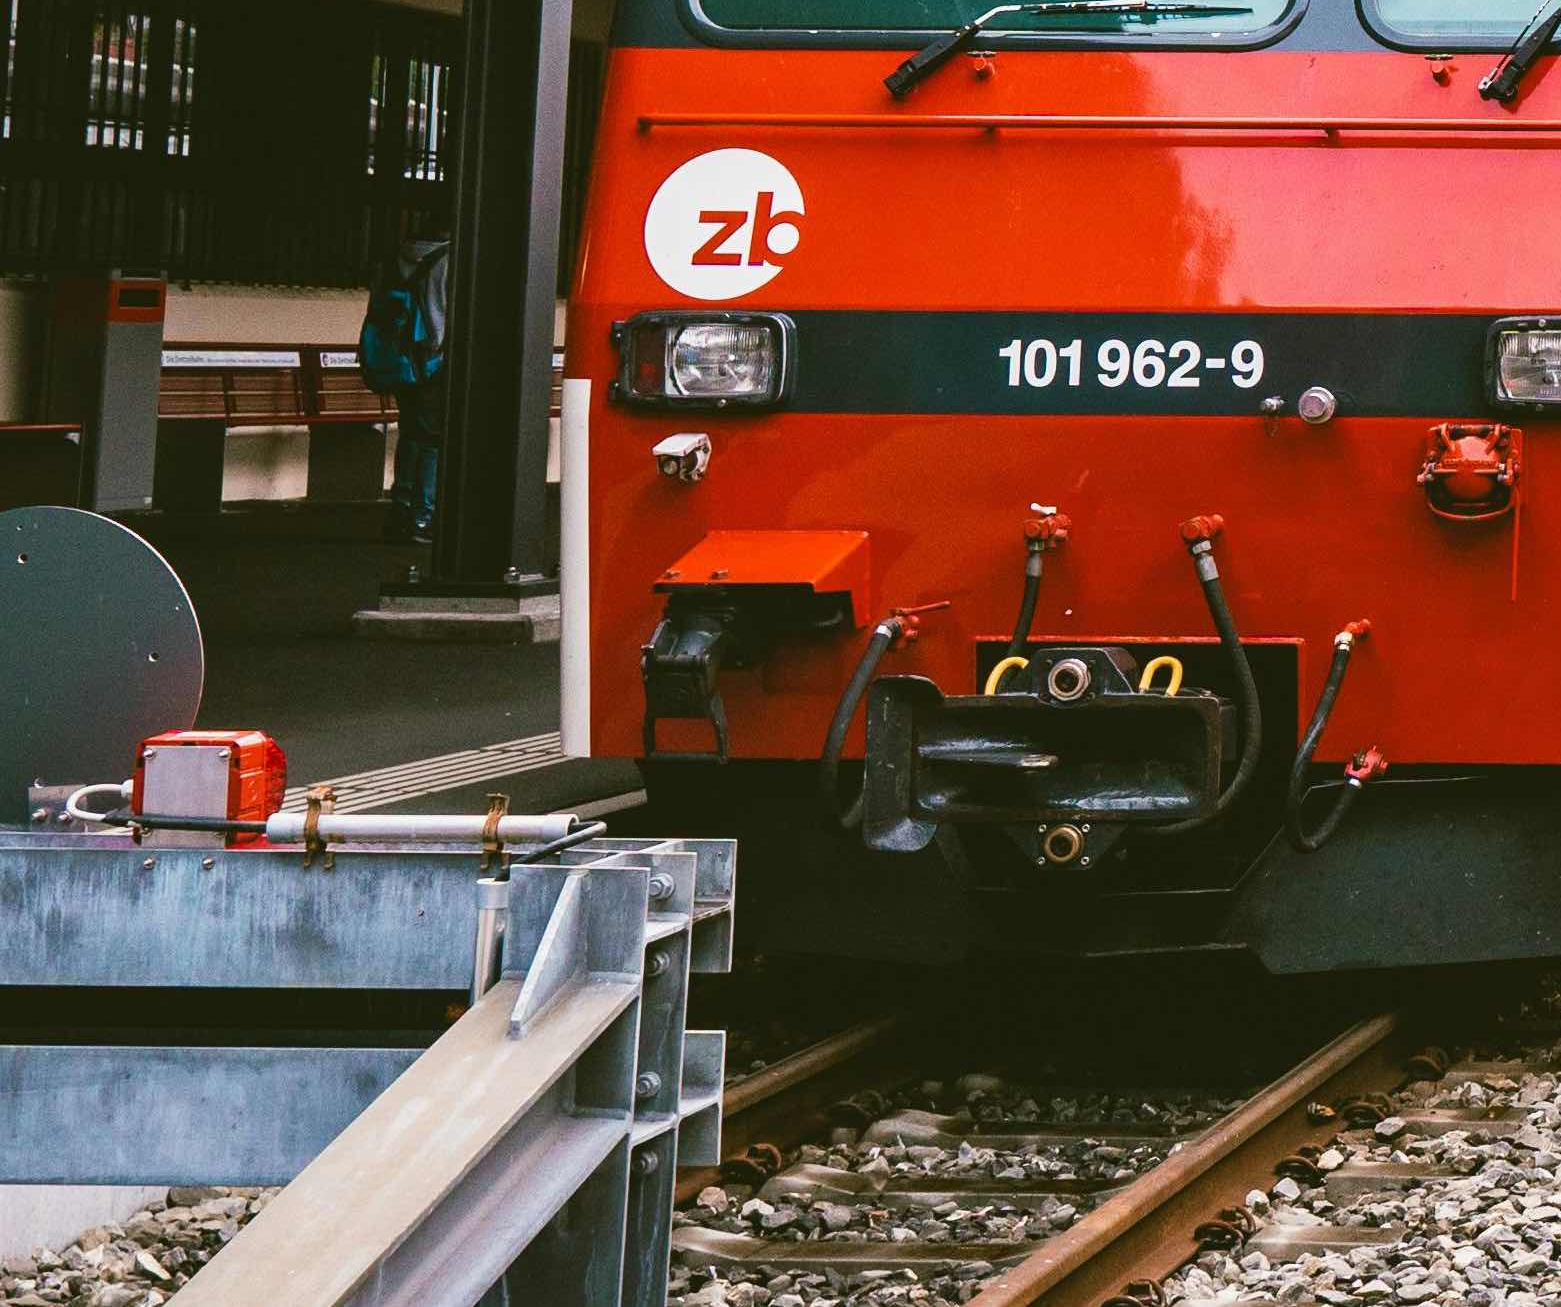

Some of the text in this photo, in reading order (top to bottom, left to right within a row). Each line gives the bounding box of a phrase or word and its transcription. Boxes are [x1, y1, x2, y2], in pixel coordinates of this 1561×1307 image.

[691, 191, 804, 266] zb
[999, 339, 1265, 389] 101 962-9
